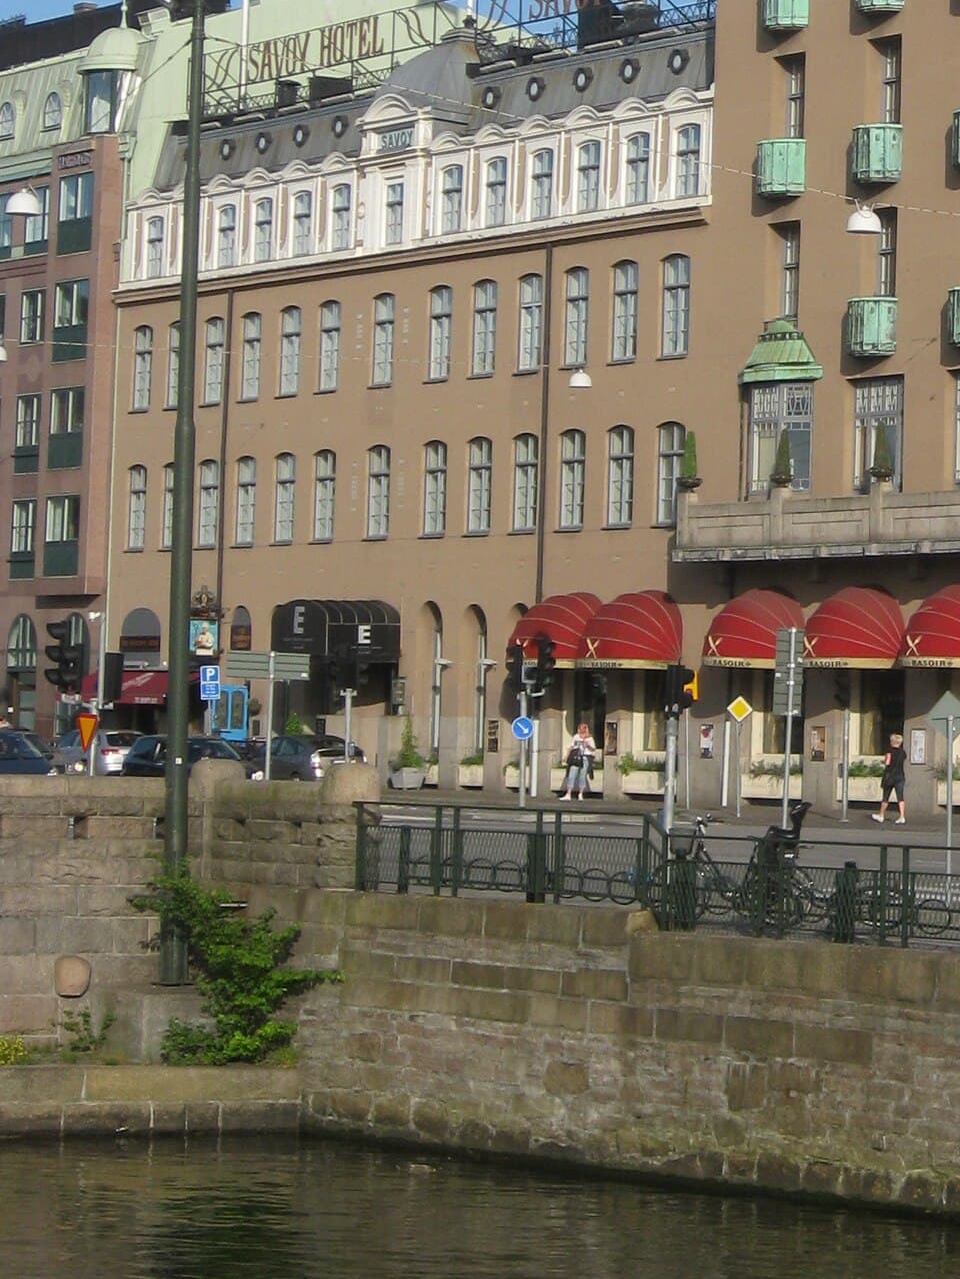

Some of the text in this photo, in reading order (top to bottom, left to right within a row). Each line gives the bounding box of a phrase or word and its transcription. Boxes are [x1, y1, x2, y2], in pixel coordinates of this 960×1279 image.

[247, 16, 385, 81] SAVOY HOTEL
[381, 130, 413, 149] SAVOY
[293, 605, 306, 635] E
[357, 625, 371, 644] E
[911, 659, 946, 667] RASOIR
[206, 668, 216, 682] P
